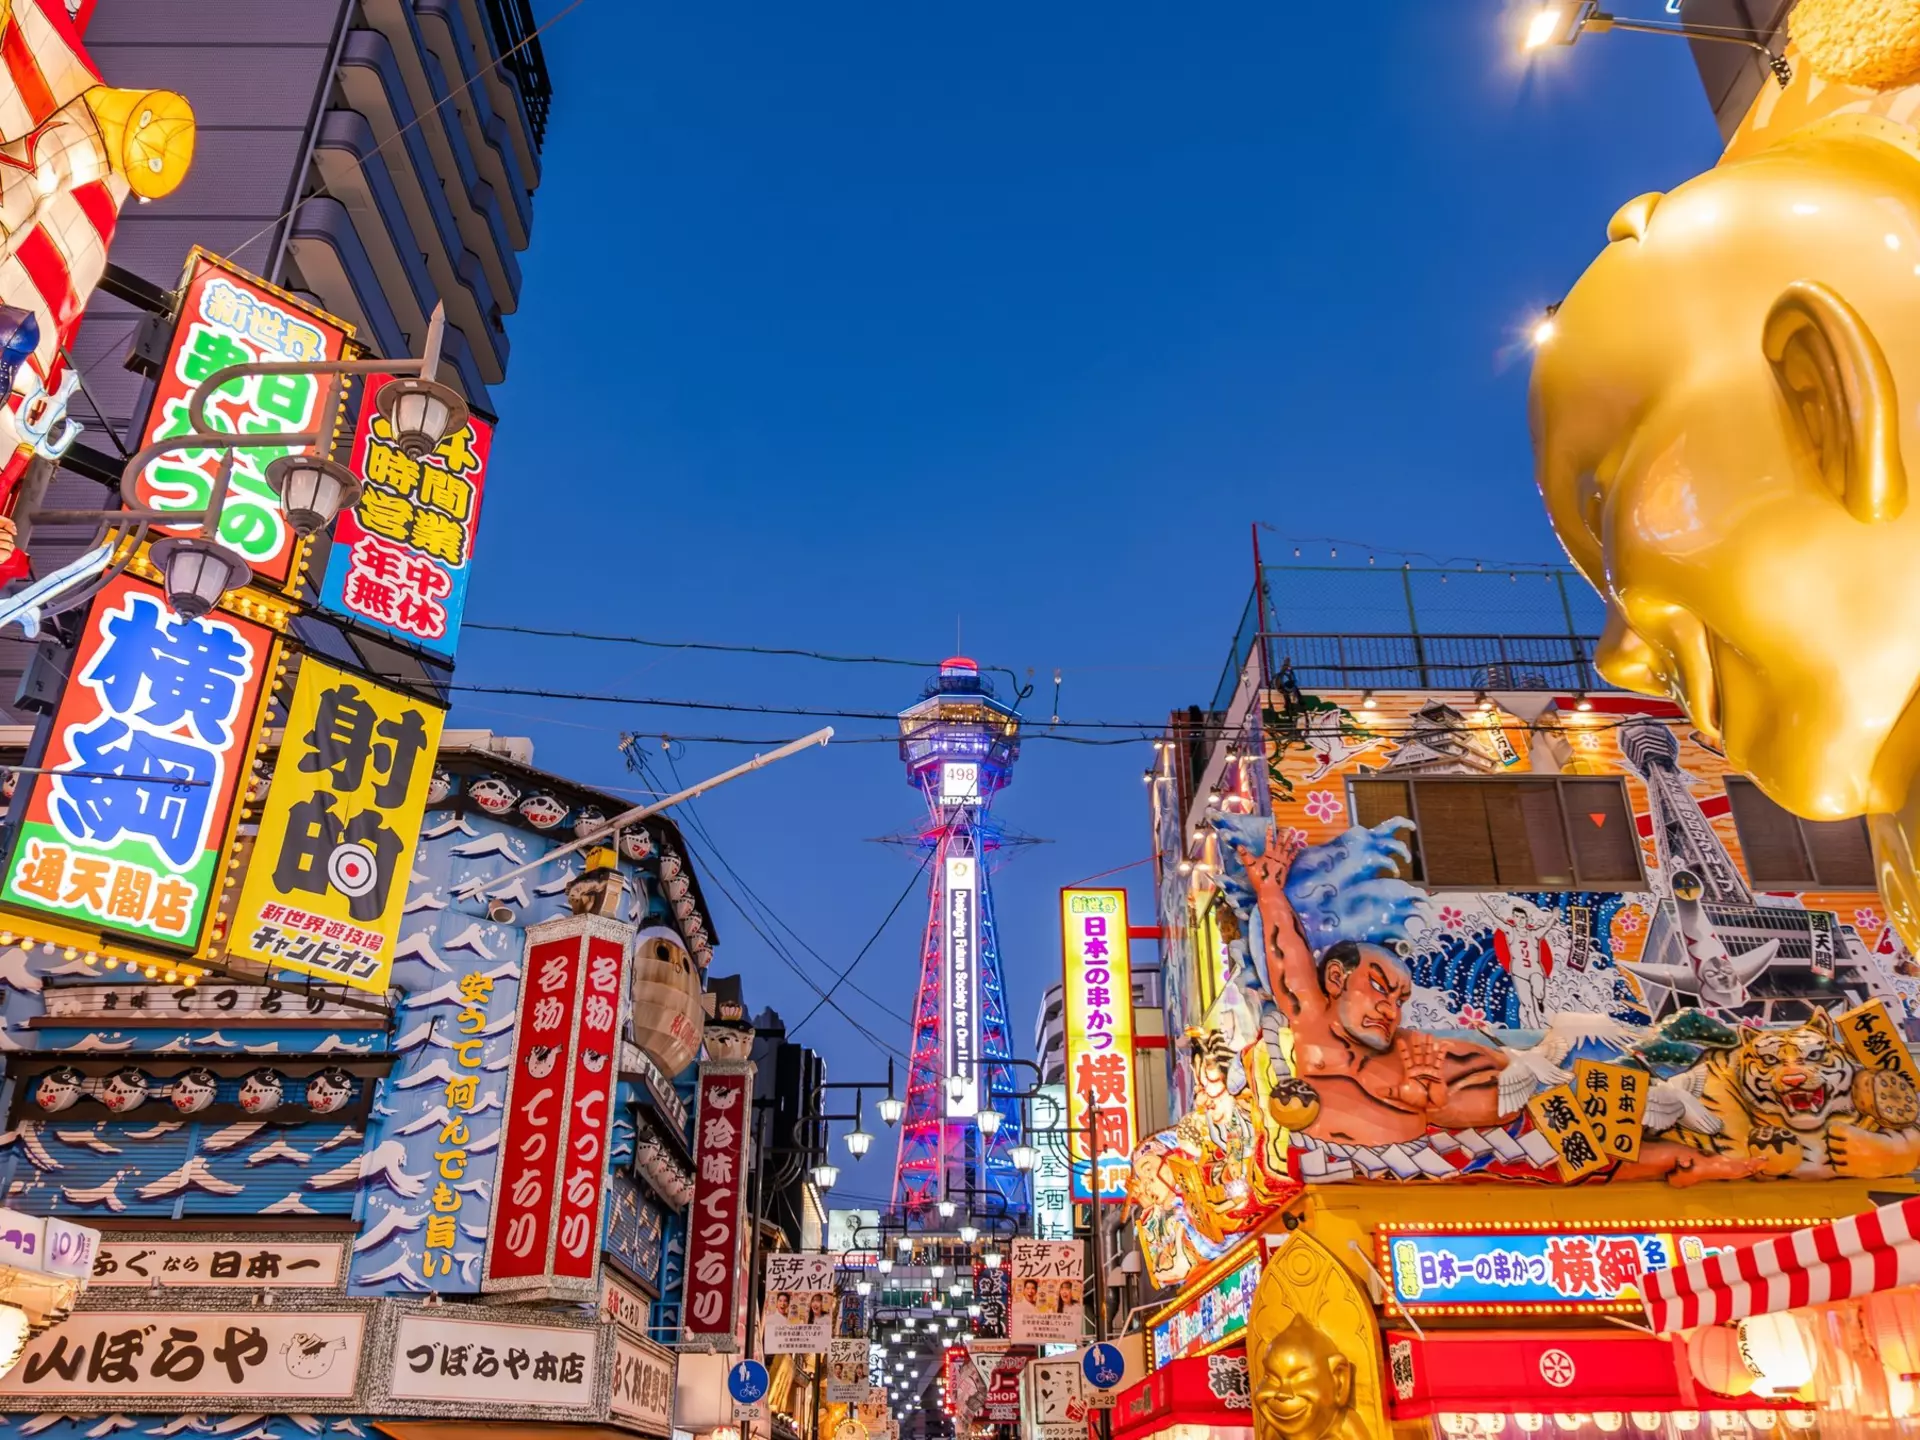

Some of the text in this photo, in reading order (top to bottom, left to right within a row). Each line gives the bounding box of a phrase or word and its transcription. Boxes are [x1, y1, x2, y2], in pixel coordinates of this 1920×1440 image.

[207, 283, 322, 363] 新世界
[368, 443, 470, 519] 時間
[358, 487, 464, 565] 営業
[357, 540, 448, 598] 年中
[350, 573, 443, 637] 無休
[56, 600, 247, 866] 横綱
[939, 796, 982, 805] HITACHI
[946, 768, 975, 781] 498
[271, 684, 428, 922] 射的
[17, 843, 193, 932] 通天閣店
[952, 890, 967, 938] Designing
[252, 926, 382, 977] チャンピオン
[260, 903, 385, 951] 新世界遊技場
[954, 939, 967, 970] Future
[951, 972, 968, 1009] Society
[1084, 916, 1114, 1050] 日本一の串かつ
[422, 971, 495, 1278] 安うて何んでも旨い
[1076, 1053, 1130, 1159] 横綱
[1584, 1068, 1609, 1143] 串かつ
[1614, 1074, 1636, 1153] 日本一の
[768, 1258, 805, 1275] 忘年
[1014, 1244, 1052, 1261] 忘年
[1420, 1254, 1546, 1287] 日本一の串かつ
[1550, 1240, 1642, 1294] 横綱
[406, 1341, 587, 1385] づぼらや本店
[986, 1392, 1017, 1401] SHOP
